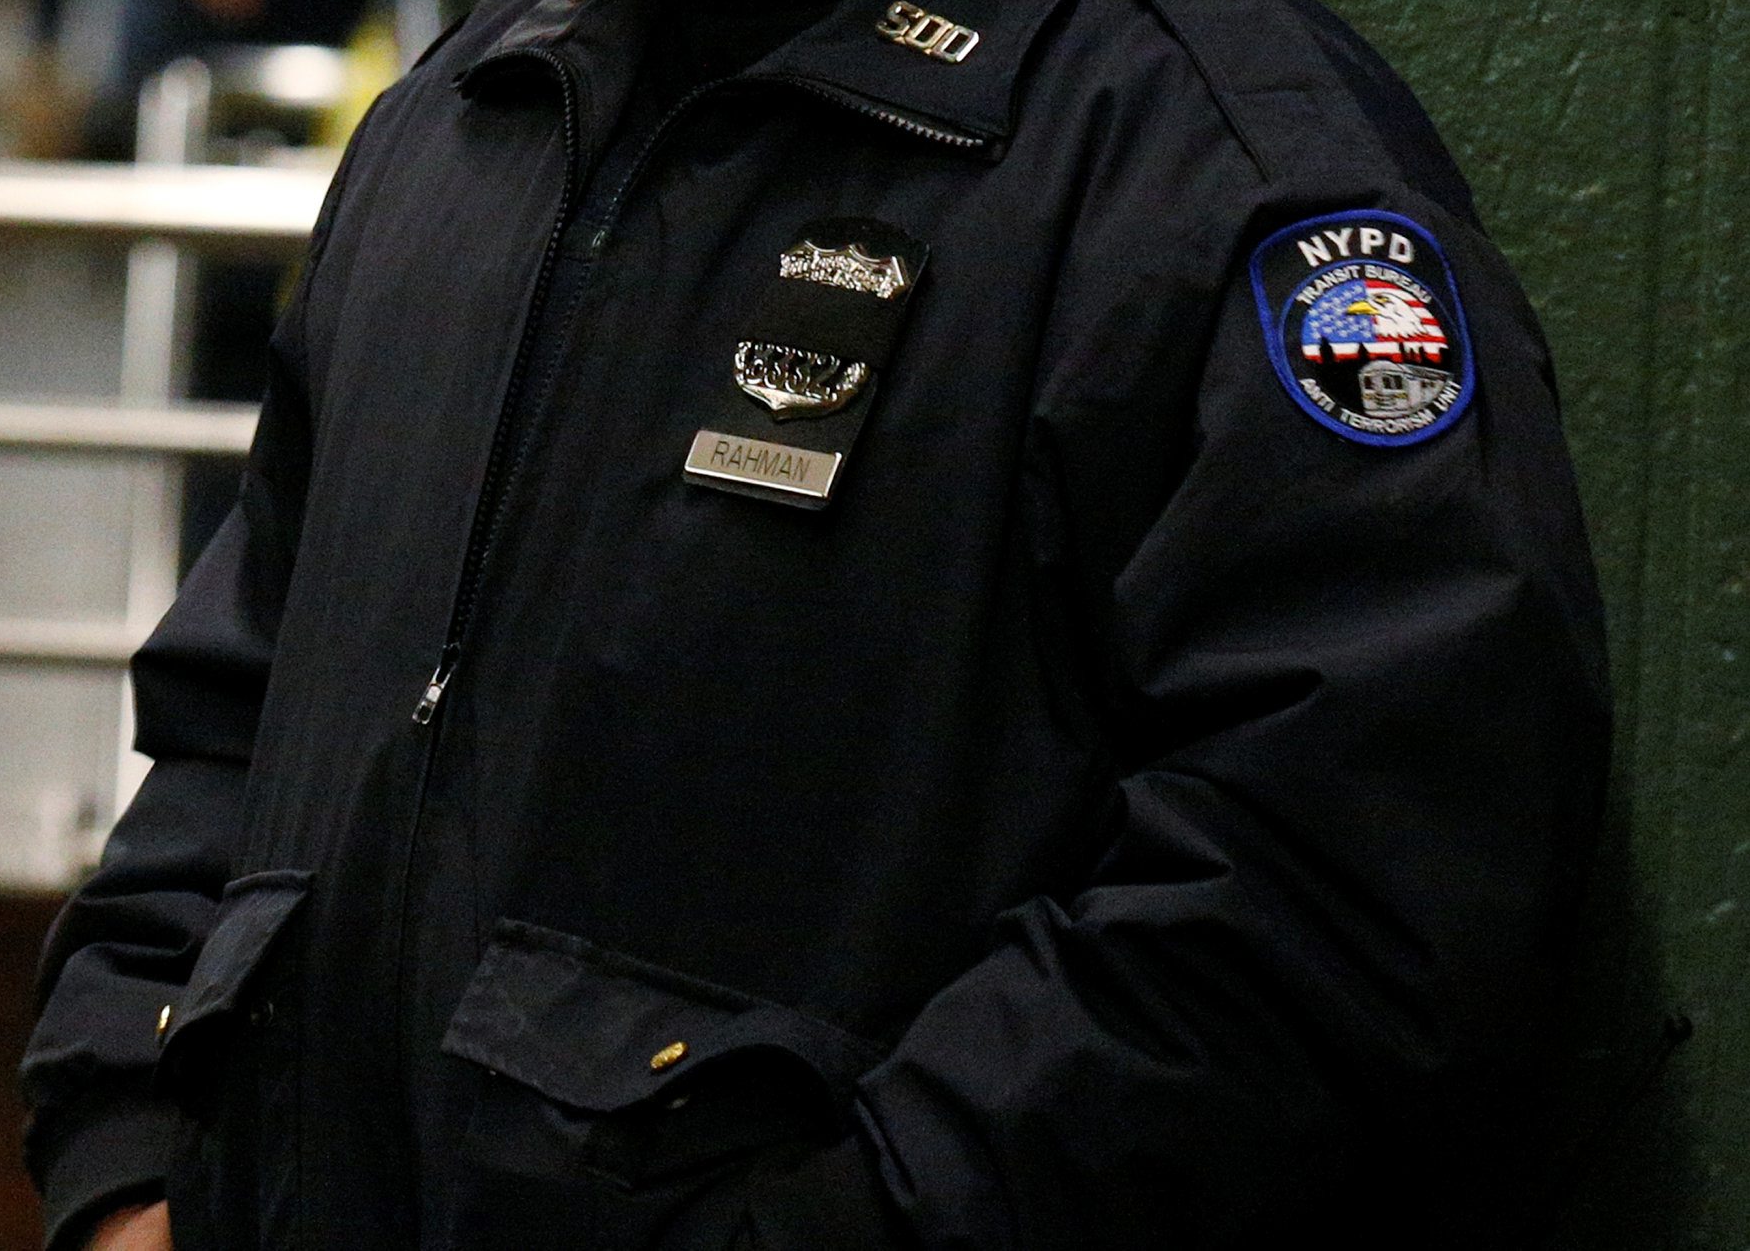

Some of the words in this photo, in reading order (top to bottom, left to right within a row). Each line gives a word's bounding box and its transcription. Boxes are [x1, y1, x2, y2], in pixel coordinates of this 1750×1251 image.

[1297, 227, 1415, 266] NYPD
[1295, 265, 1362, 306] TRANSIT
[1364, 264, 1433, 304] BUREAU
[1433, 380, 1462, 412] UNIT
[709, 440, 811, 483] RAHMAN
